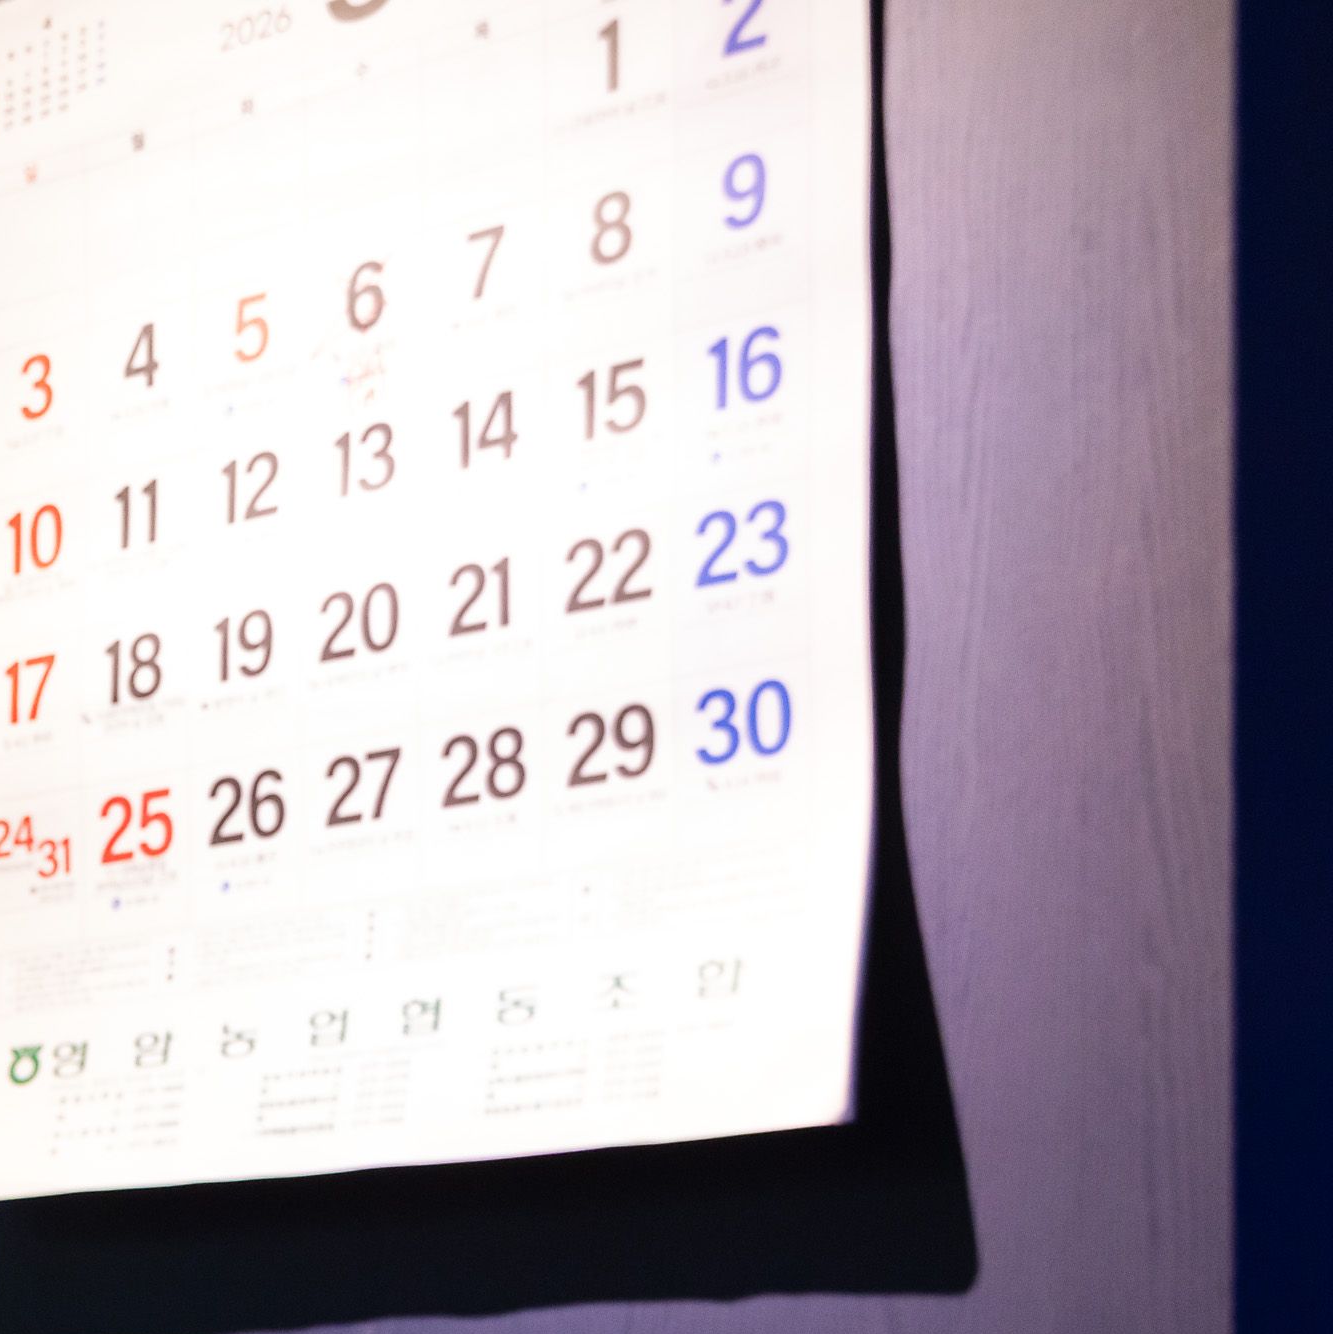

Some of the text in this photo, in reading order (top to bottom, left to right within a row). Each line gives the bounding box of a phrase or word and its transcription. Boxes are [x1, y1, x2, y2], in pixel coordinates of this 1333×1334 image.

[218, 5, 294, 53] 2026
[598, 0, 769, 92] 1 2
[19, 352, 54, 422] 3
[123, 322, 160, 388] 4
[234, 292, 270, 364] 5
[346, 260, 386, 334] 6
[468, 224, 505, 299] 7
[590, 190, 633, 266] 8
[722, 152, 767, 231] 9
[5, 324, 783, 577] 10 11 12 13 14 15 16
[4, 498, 790, 727] 17 18 19 20 21 22 23
[36, 836, 71, 879] 31
[98, 678, 794, 867] 25 26 27 28 29 30
